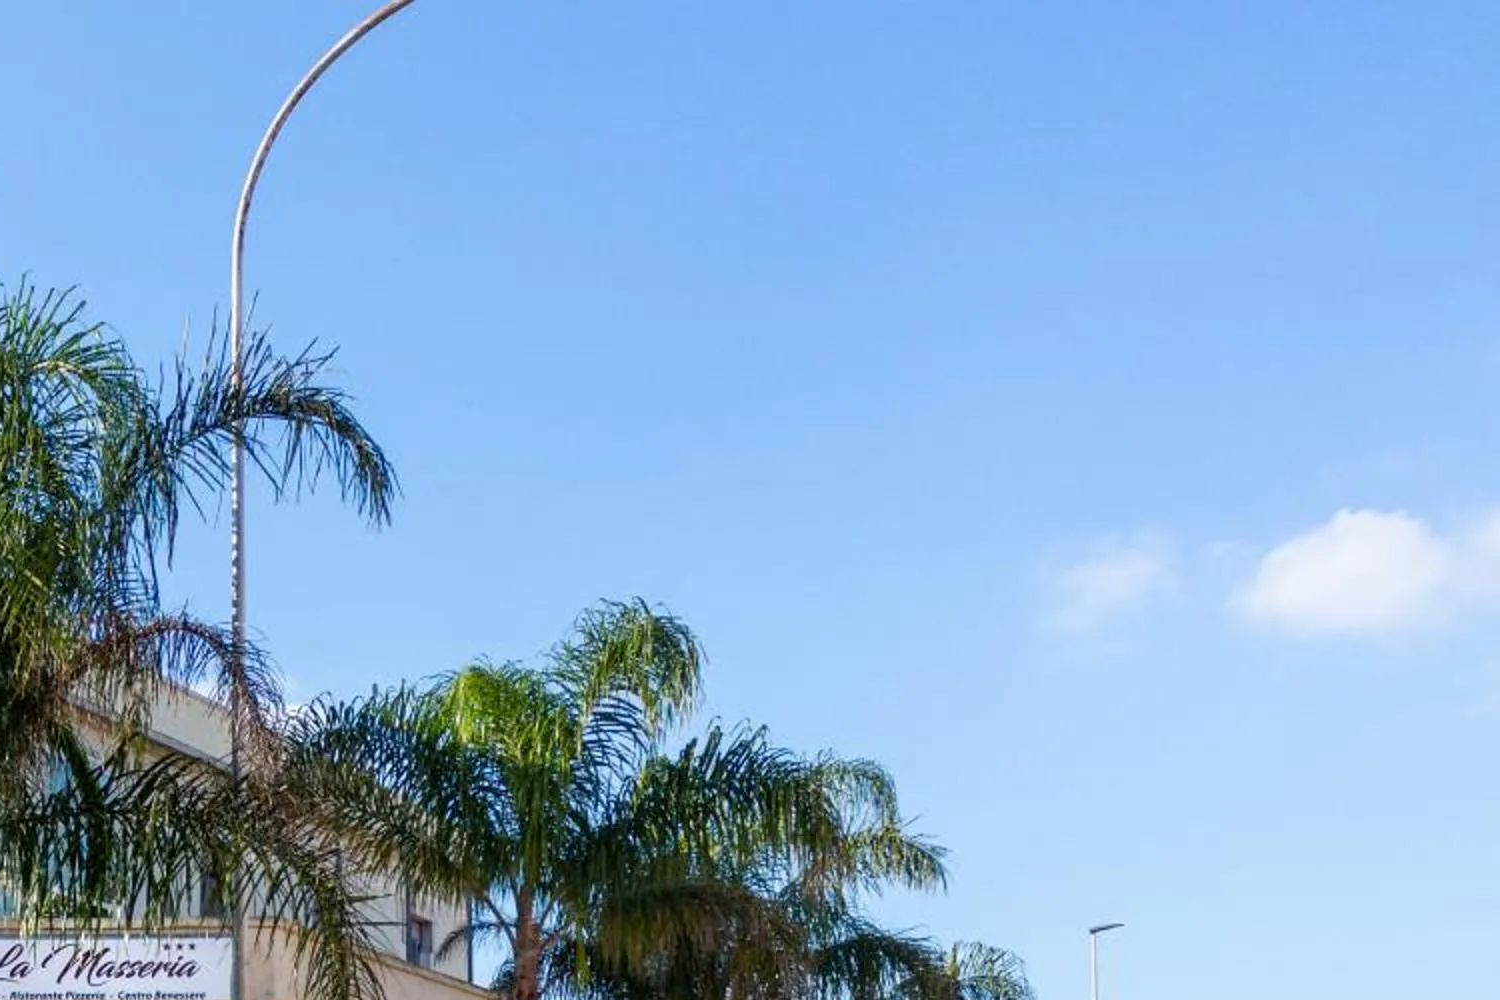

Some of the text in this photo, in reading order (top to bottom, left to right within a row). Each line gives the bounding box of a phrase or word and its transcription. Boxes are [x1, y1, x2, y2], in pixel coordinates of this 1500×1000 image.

[42, 943, 200, 987] Masseria
[9, 990, 63, 1000] Ristorante
[65, 990, 106, 1000] Pizzeria
[117, 990, 153, 1000] Centro
[154, 990, 207, 1000] Benessere
